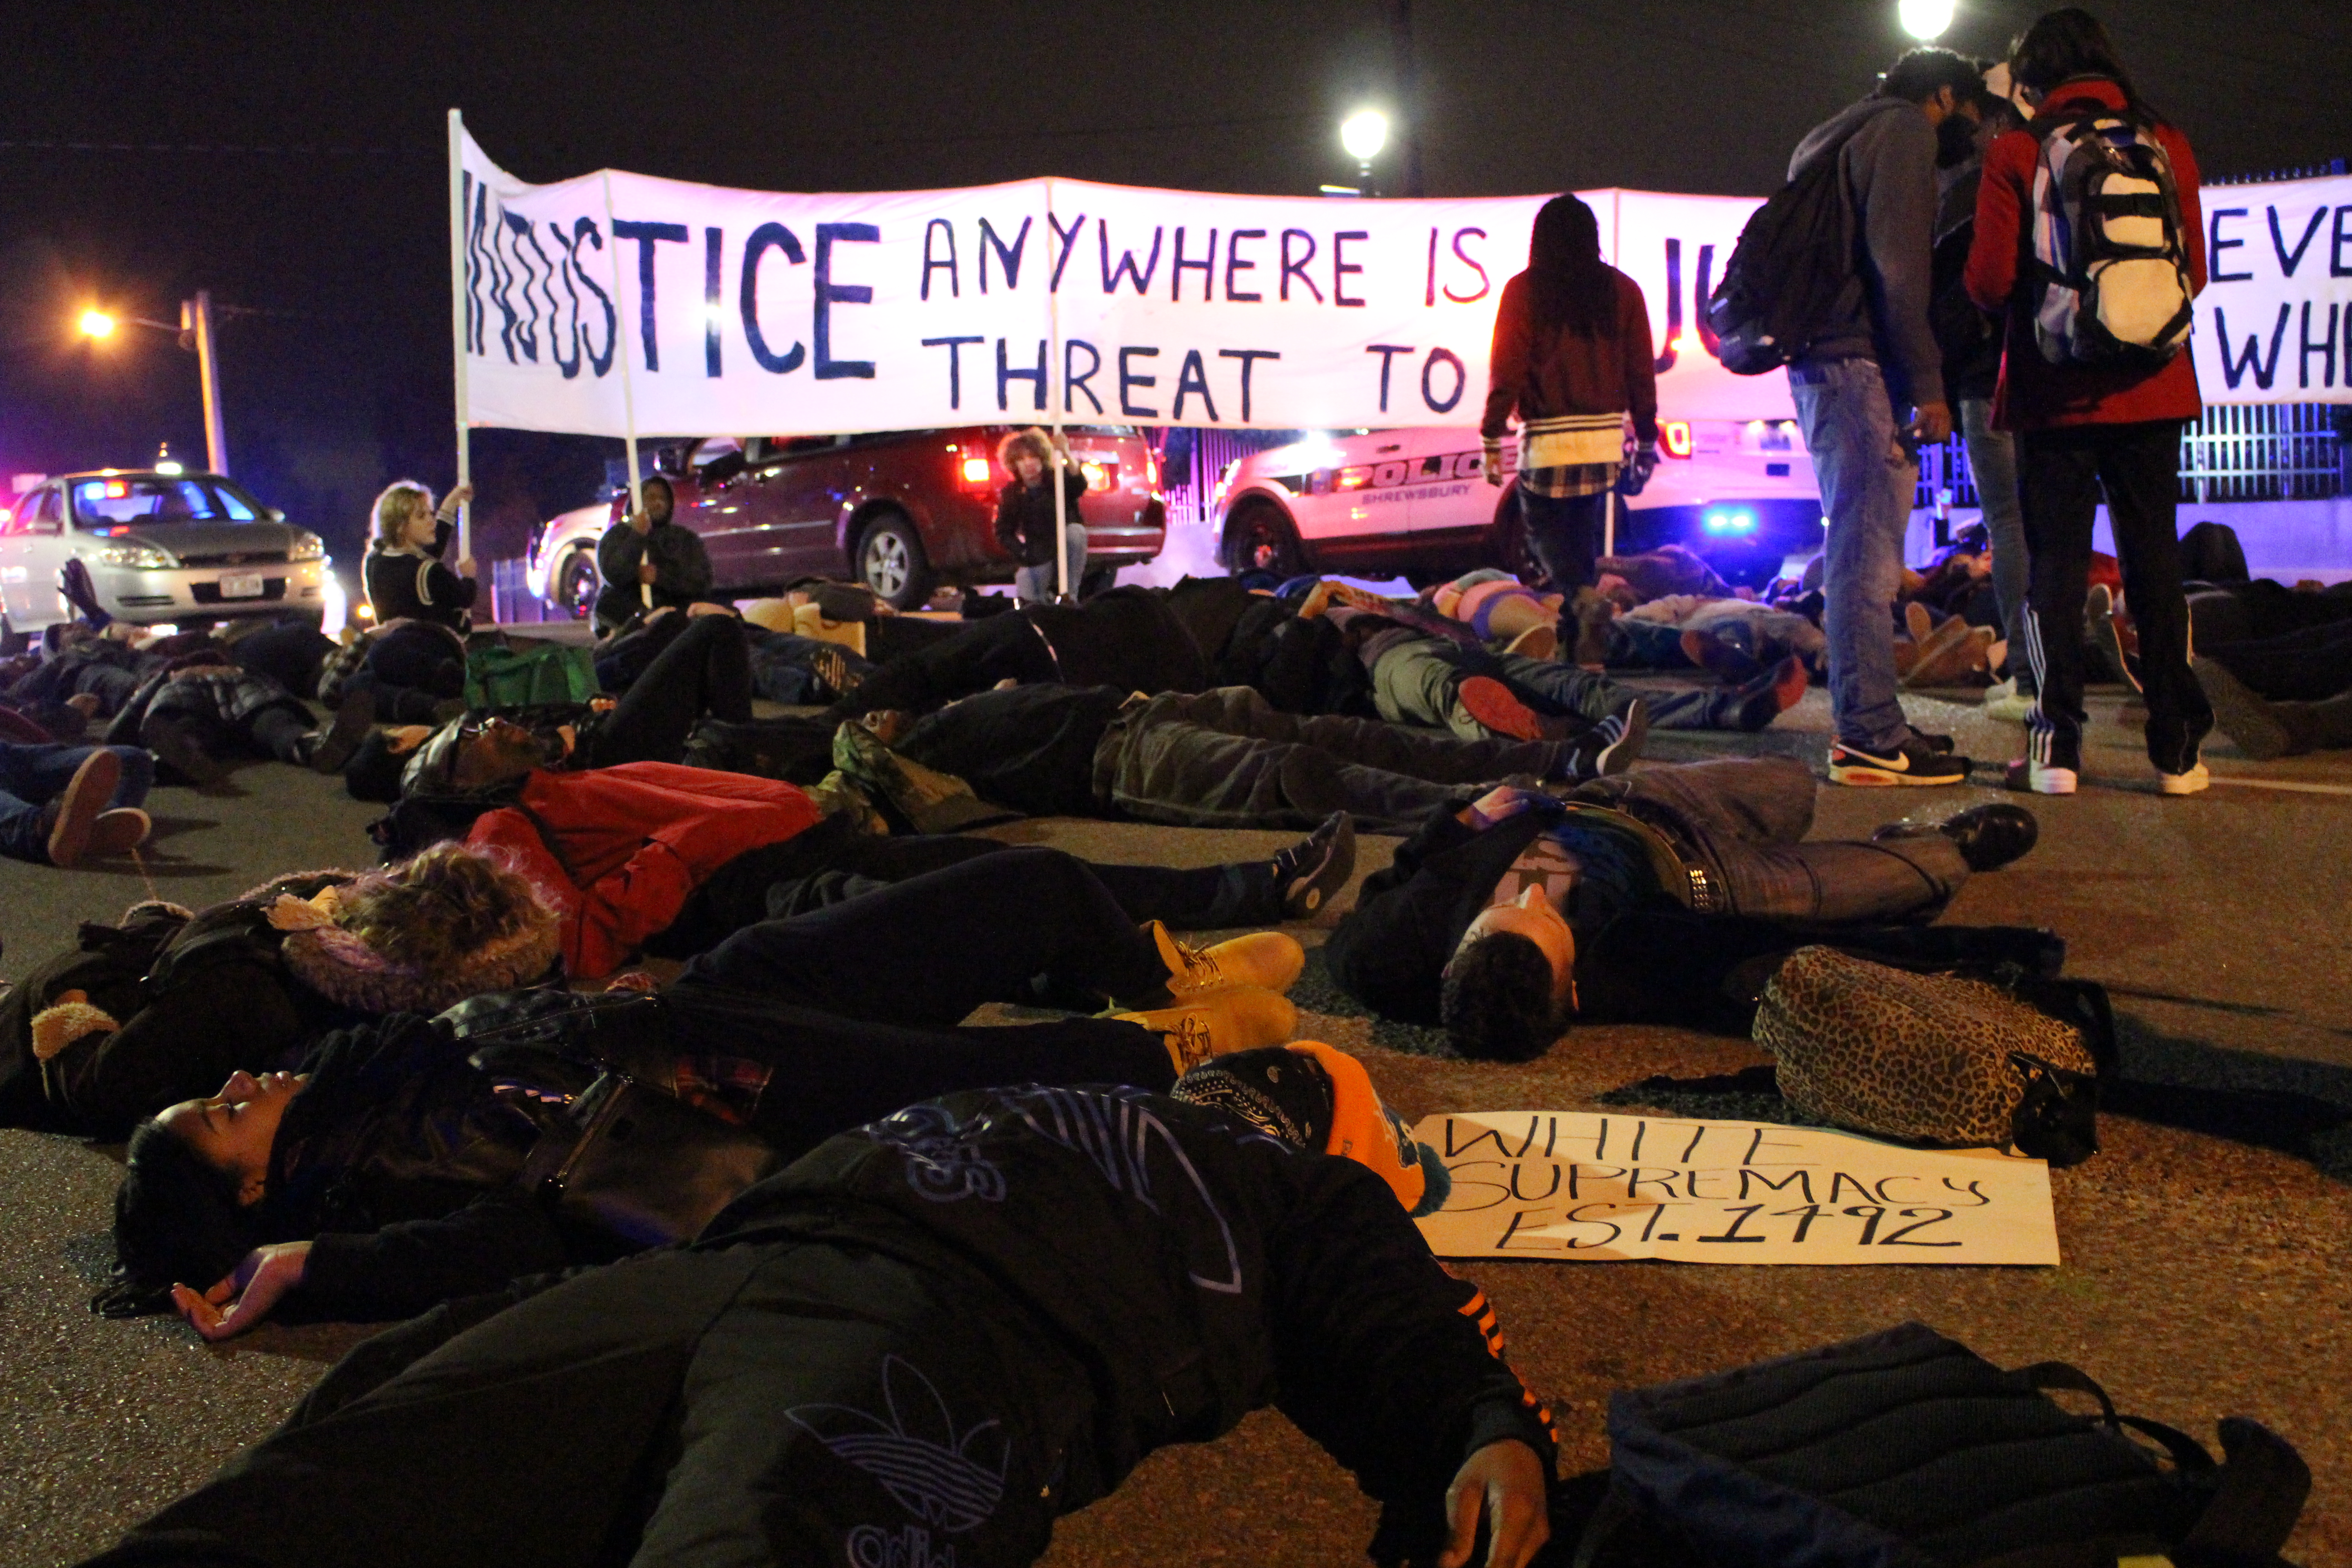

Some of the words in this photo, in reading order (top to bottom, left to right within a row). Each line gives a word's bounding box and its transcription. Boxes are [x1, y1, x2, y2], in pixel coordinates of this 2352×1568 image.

[921, 211, 1369, 307] ANYWHERE
[1425, 226, 1490, 307] IS
[921, 335, 1281, 422] THREAT
[1365, 344, 1466, 414] TO
[2214, 301, 2352, 390] WH
[1362, 484, 1470, 505] SHREWSBURY
[1446, 1115, 1821, 1166] WHITE
